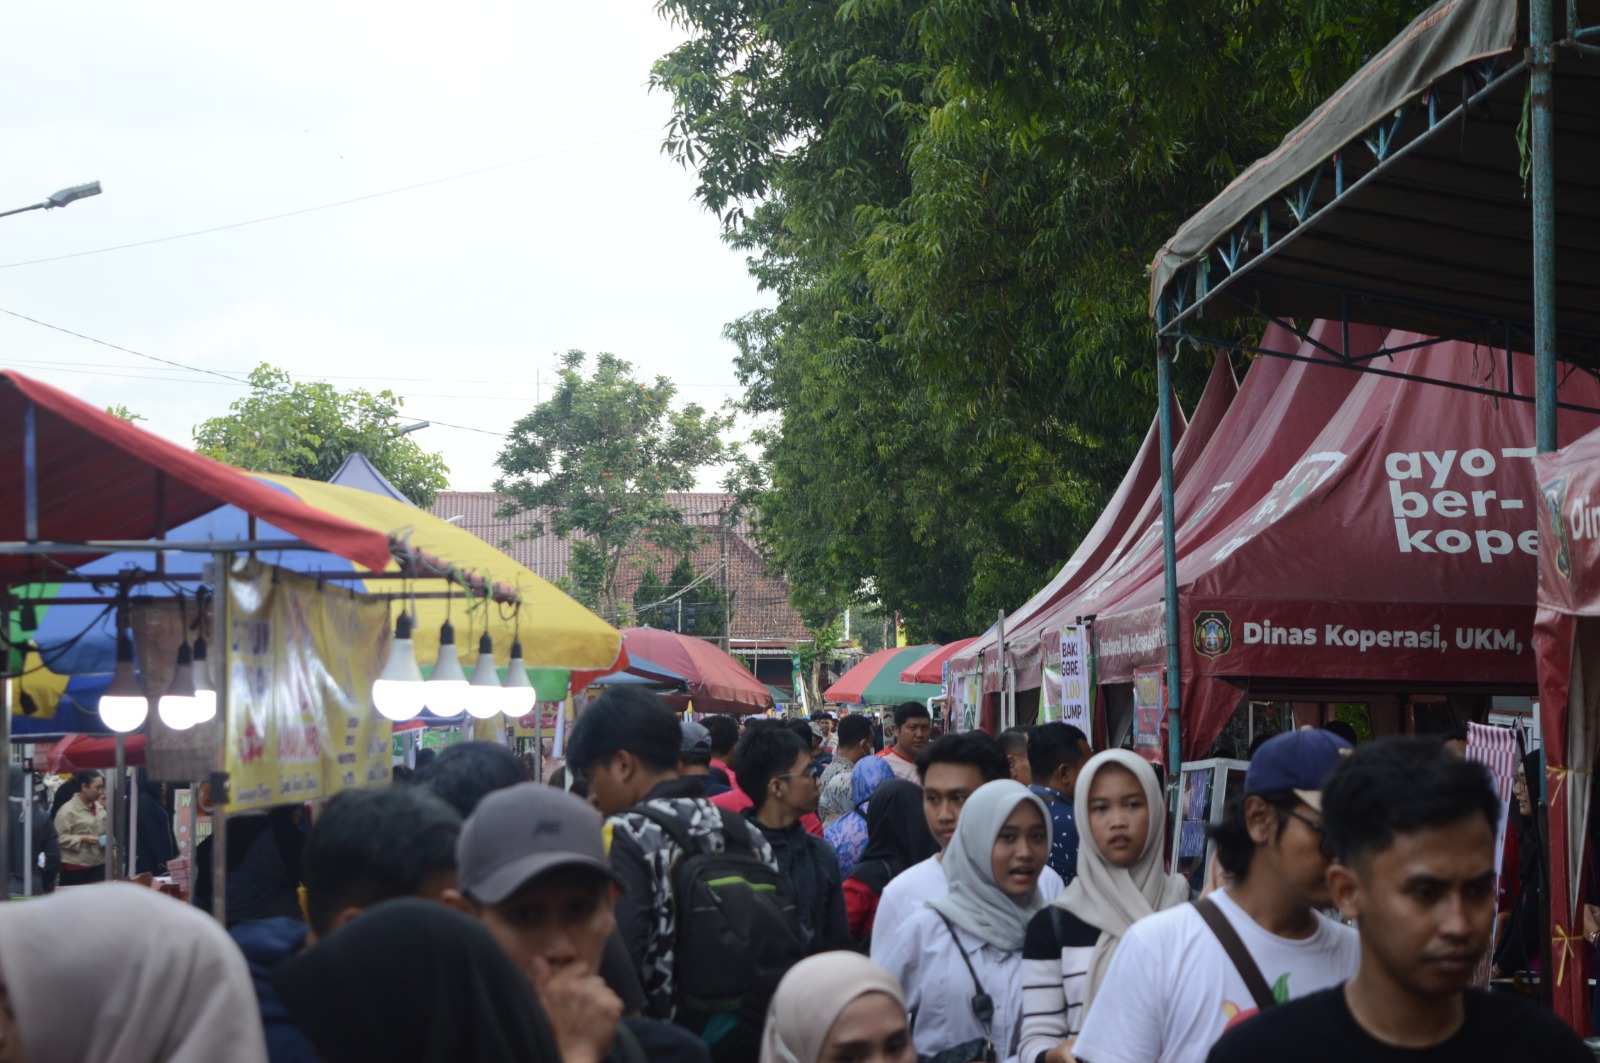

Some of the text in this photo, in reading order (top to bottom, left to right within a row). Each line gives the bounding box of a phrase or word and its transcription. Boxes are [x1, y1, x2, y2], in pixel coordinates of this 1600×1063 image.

[1385, 448, 1496, 488] ayo
[1388, 480, 1524, 518] ber-
[1243, 620, 1317, 646] Dinas
[1325, 624, 1447, 653] Koperasi,
[1455, 627, 1523, 655] UKM,
[1063, 705, 1082, 720] LUMP
